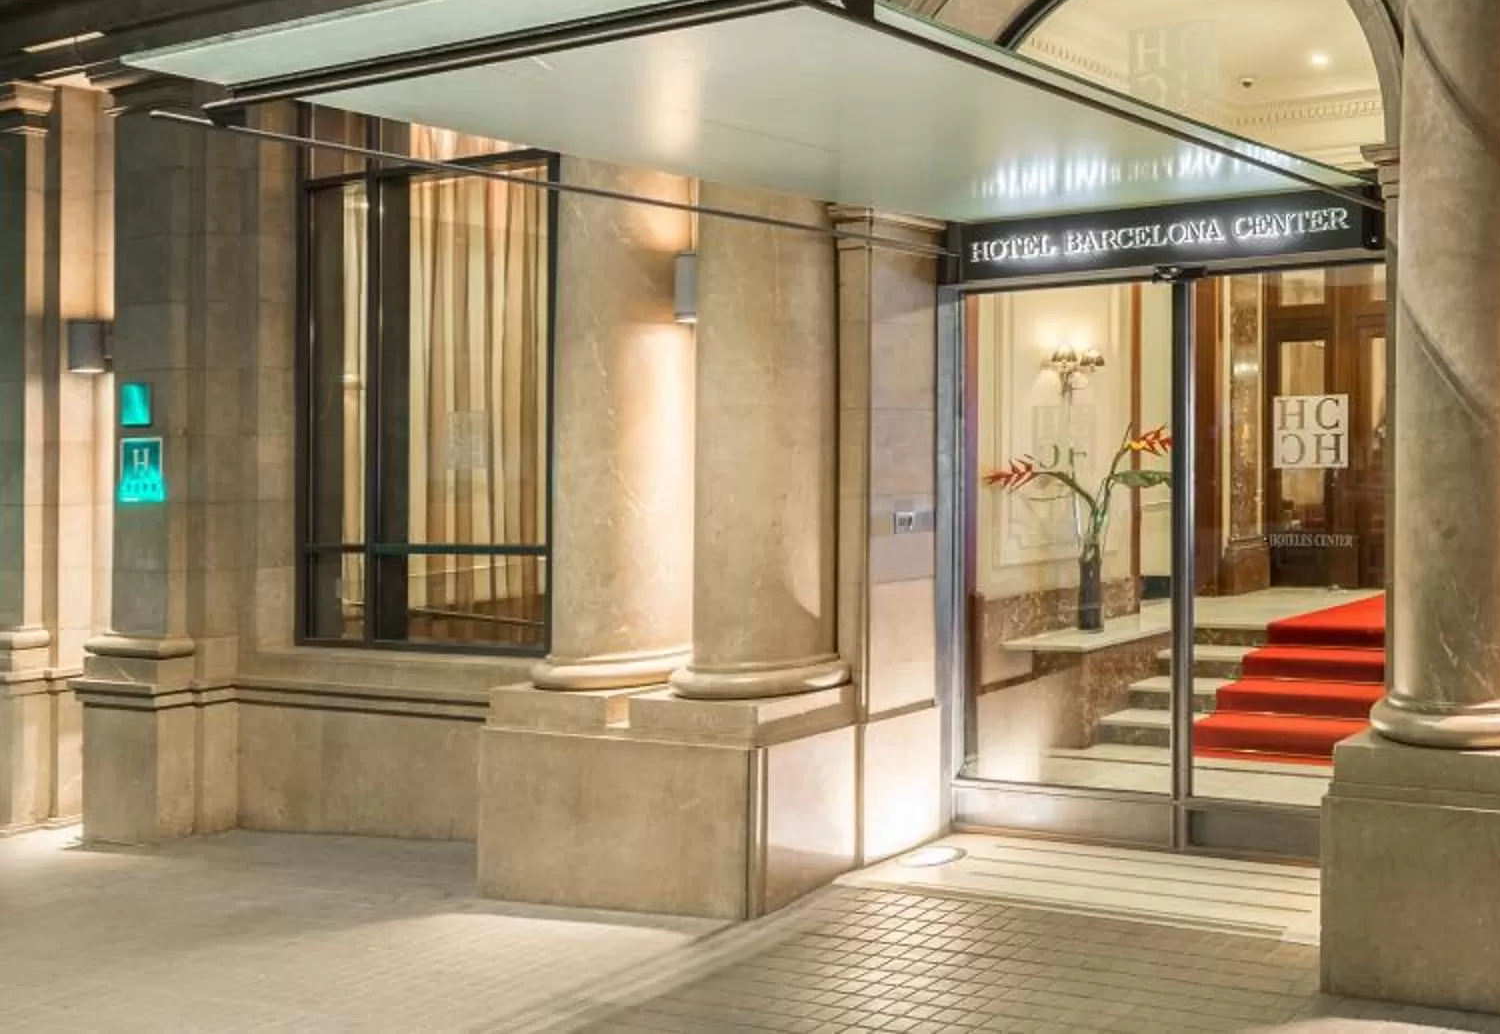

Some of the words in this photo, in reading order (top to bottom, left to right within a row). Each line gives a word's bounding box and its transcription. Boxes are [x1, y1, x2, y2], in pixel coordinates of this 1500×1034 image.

[970, 233, 1056, 263] HOTEL
[1064, 218, 1225, 256] BARCELONA
[1233, 207, 1350, 240] CENTER
[1277, 396, 1341, 431] HC
